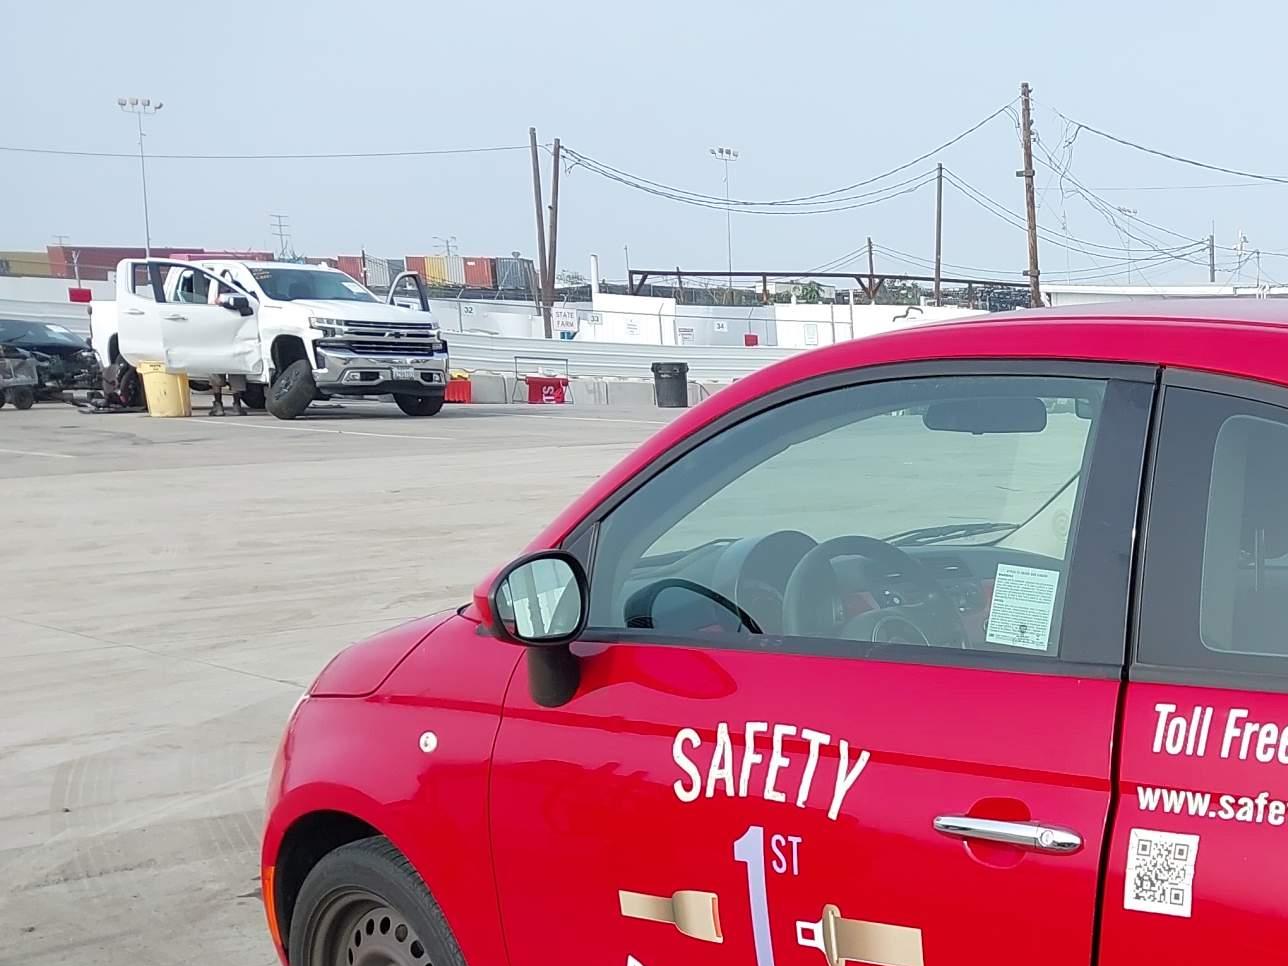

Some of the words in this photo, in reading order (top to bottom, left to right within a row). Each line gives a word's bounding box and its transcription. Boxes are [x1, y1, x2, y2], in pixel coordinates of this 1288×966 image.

[555, 311, 575, 319] STATE
[557, 320, 574, 328] FARM
[1152, 703, 1212, 757] Toll
[672, 721, 871, 821] SAFETY
